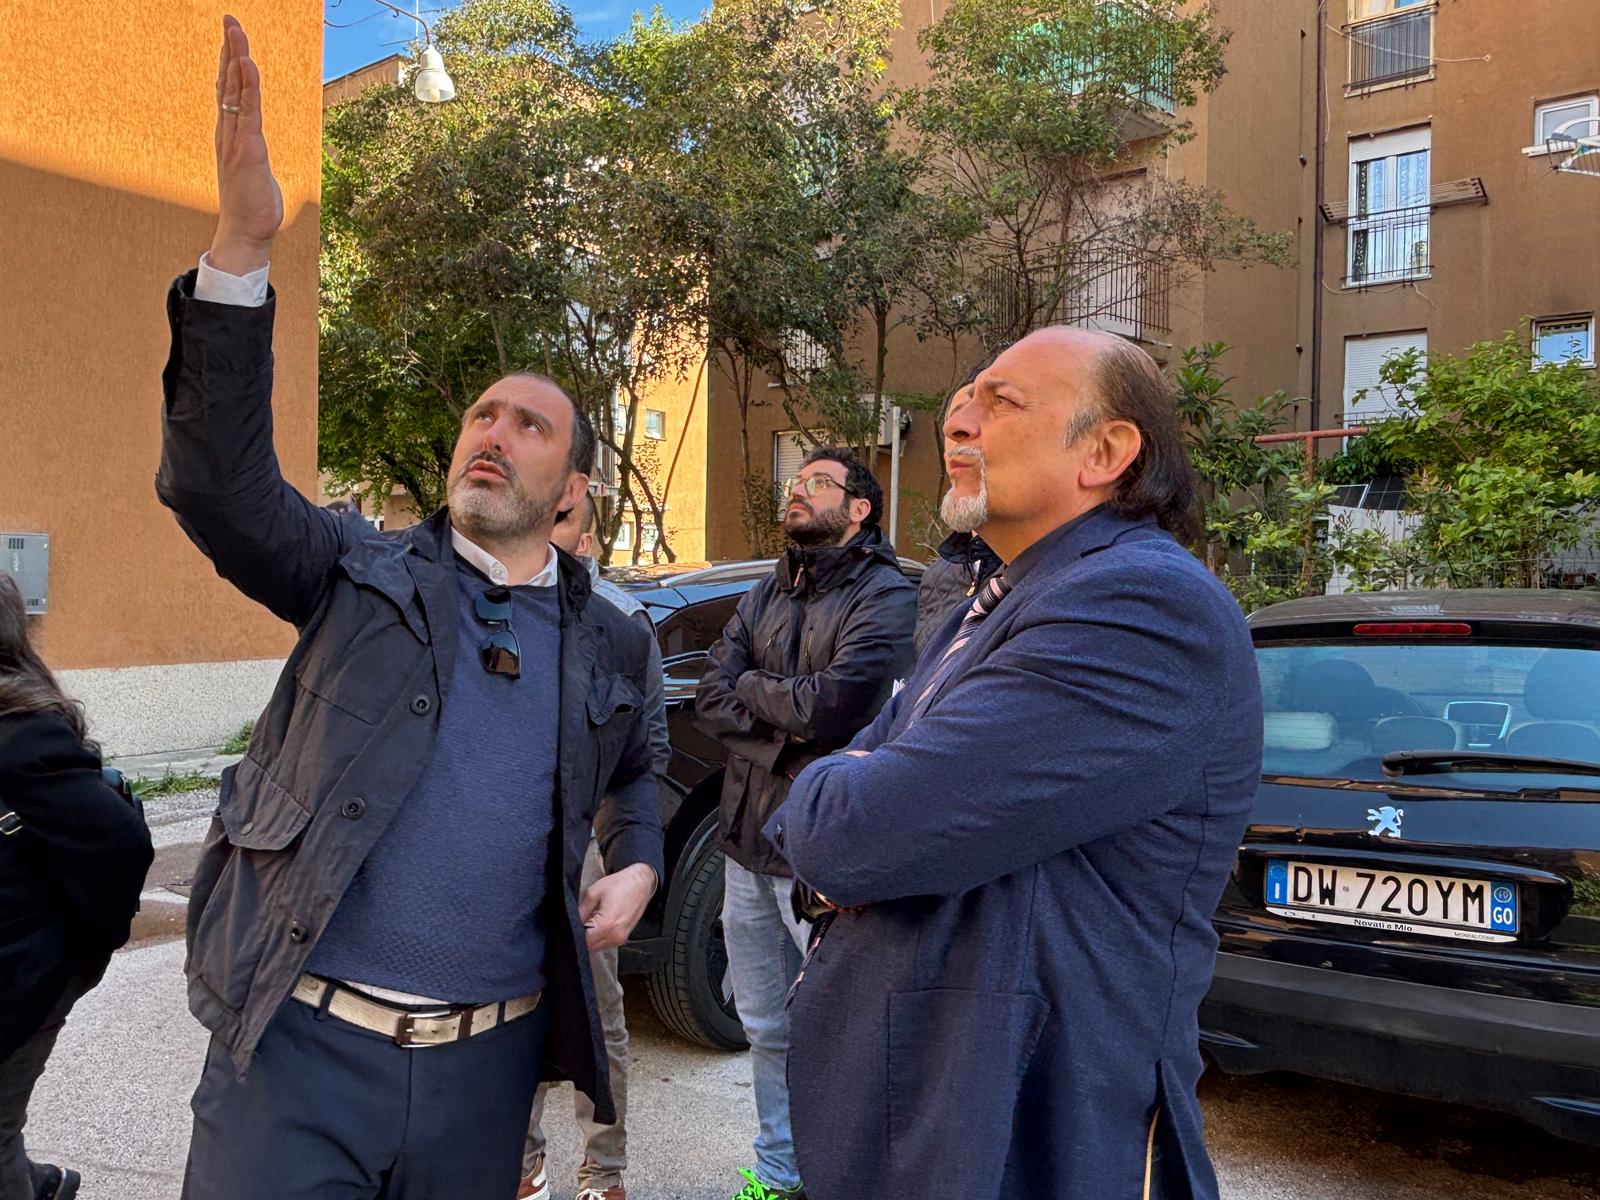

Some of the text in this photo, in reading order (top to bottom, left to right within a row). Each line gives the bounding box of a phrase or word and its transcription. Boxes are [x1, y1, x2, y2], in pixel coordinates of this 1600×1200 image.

[1293, 866, 1485, 924] DW 720YM
[1493, 906, 1513, 925] GO
